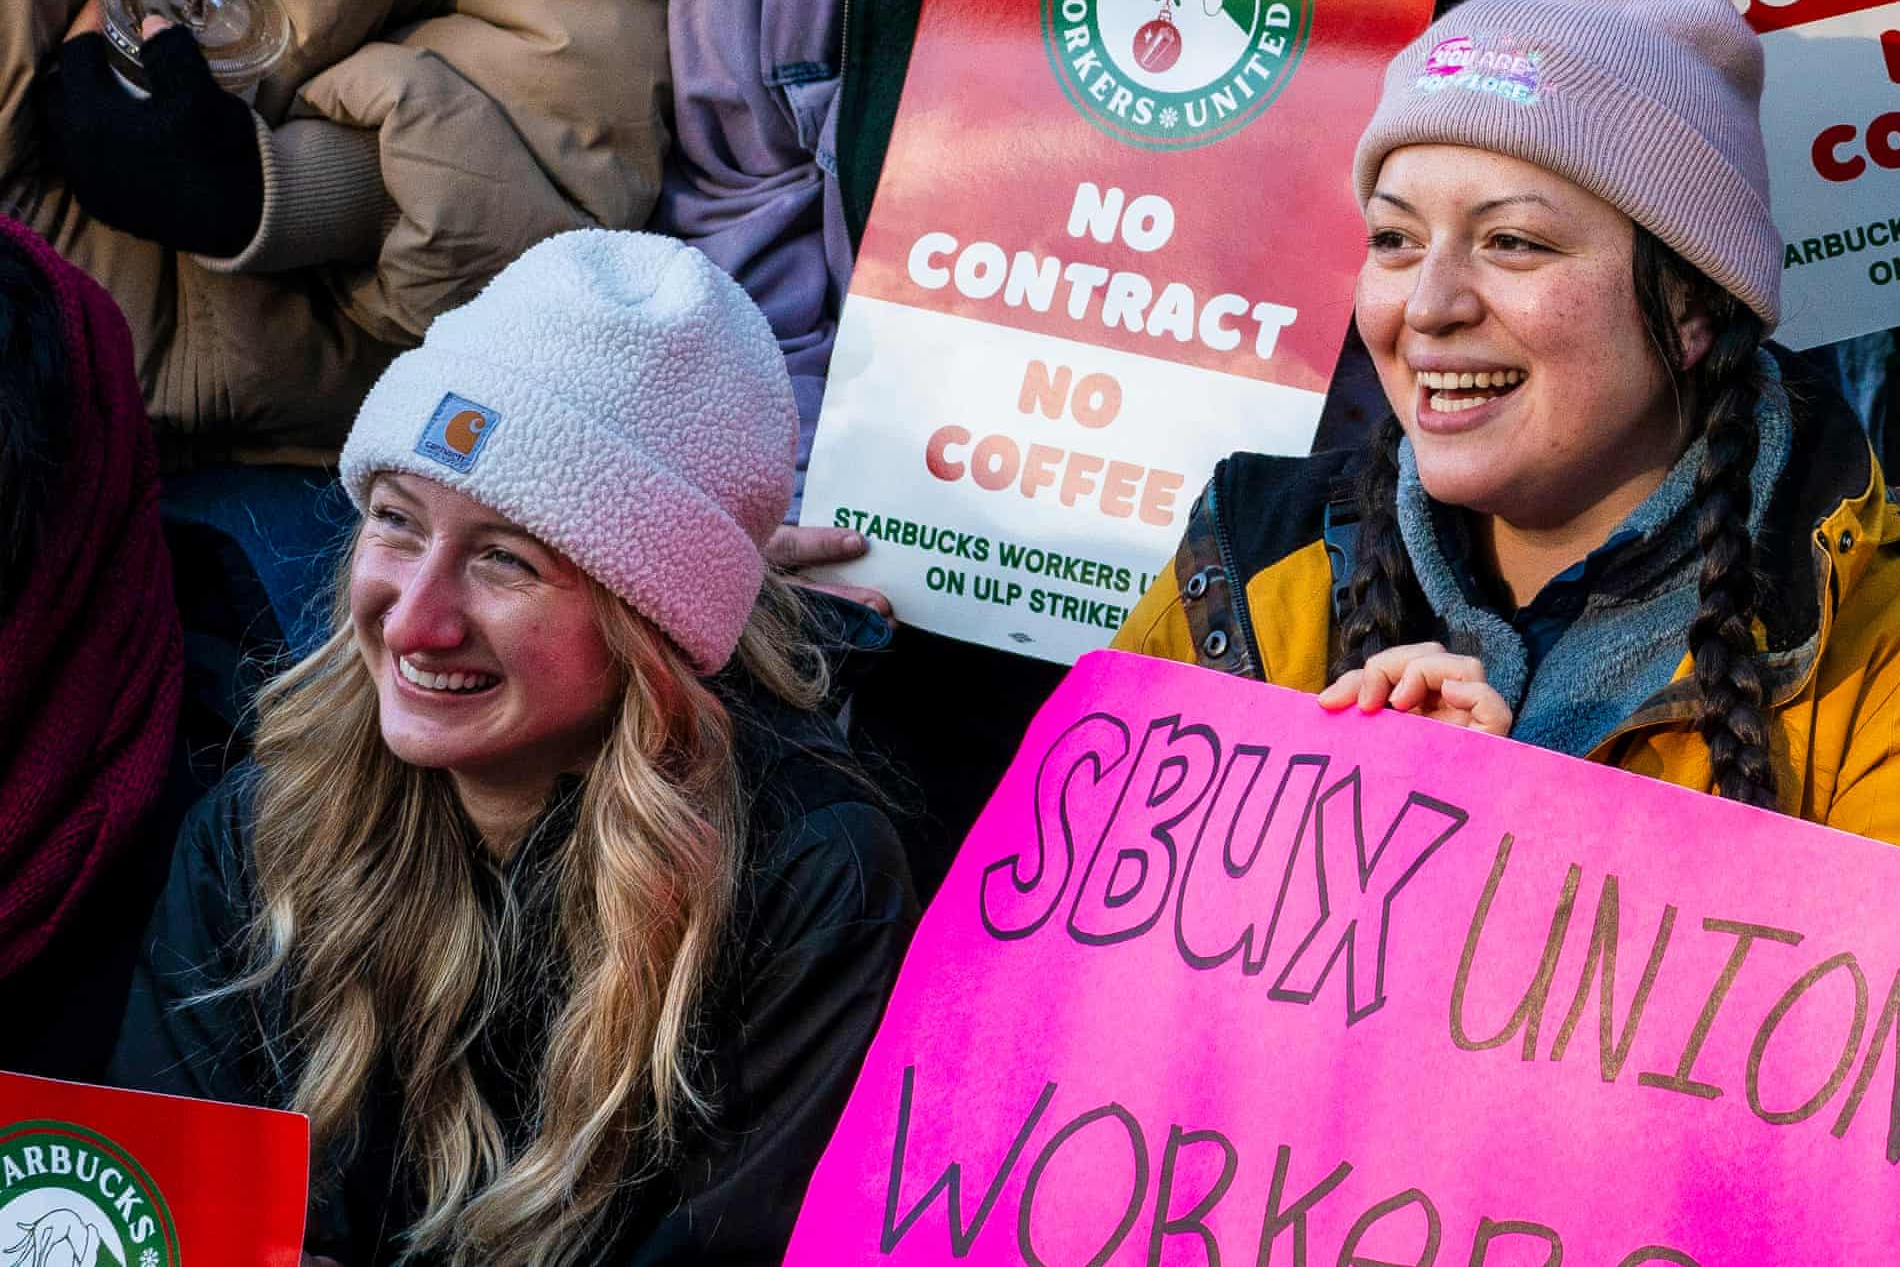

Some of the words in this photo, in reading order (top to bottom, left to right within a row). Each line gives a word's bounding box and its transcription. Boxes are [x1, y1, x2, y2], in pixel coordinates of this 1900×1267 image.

[1183, 2, 1292, 128] UNITED
[1066, 181, 1177, 254] NO
[907, 231, 1299, 361] CONTRACT
[1016, 359, 1124, 431] NO
[925, 424, 1186, 529] COFFEE
[832, 506, 991, 562] STARBUCKS
[998, 541, 1132, 593] WORKERS
[925, 566, 966, 592] ON
[972, 575, 1023, 607] ULP
[978, 711, 1470, 1027] SBUX
